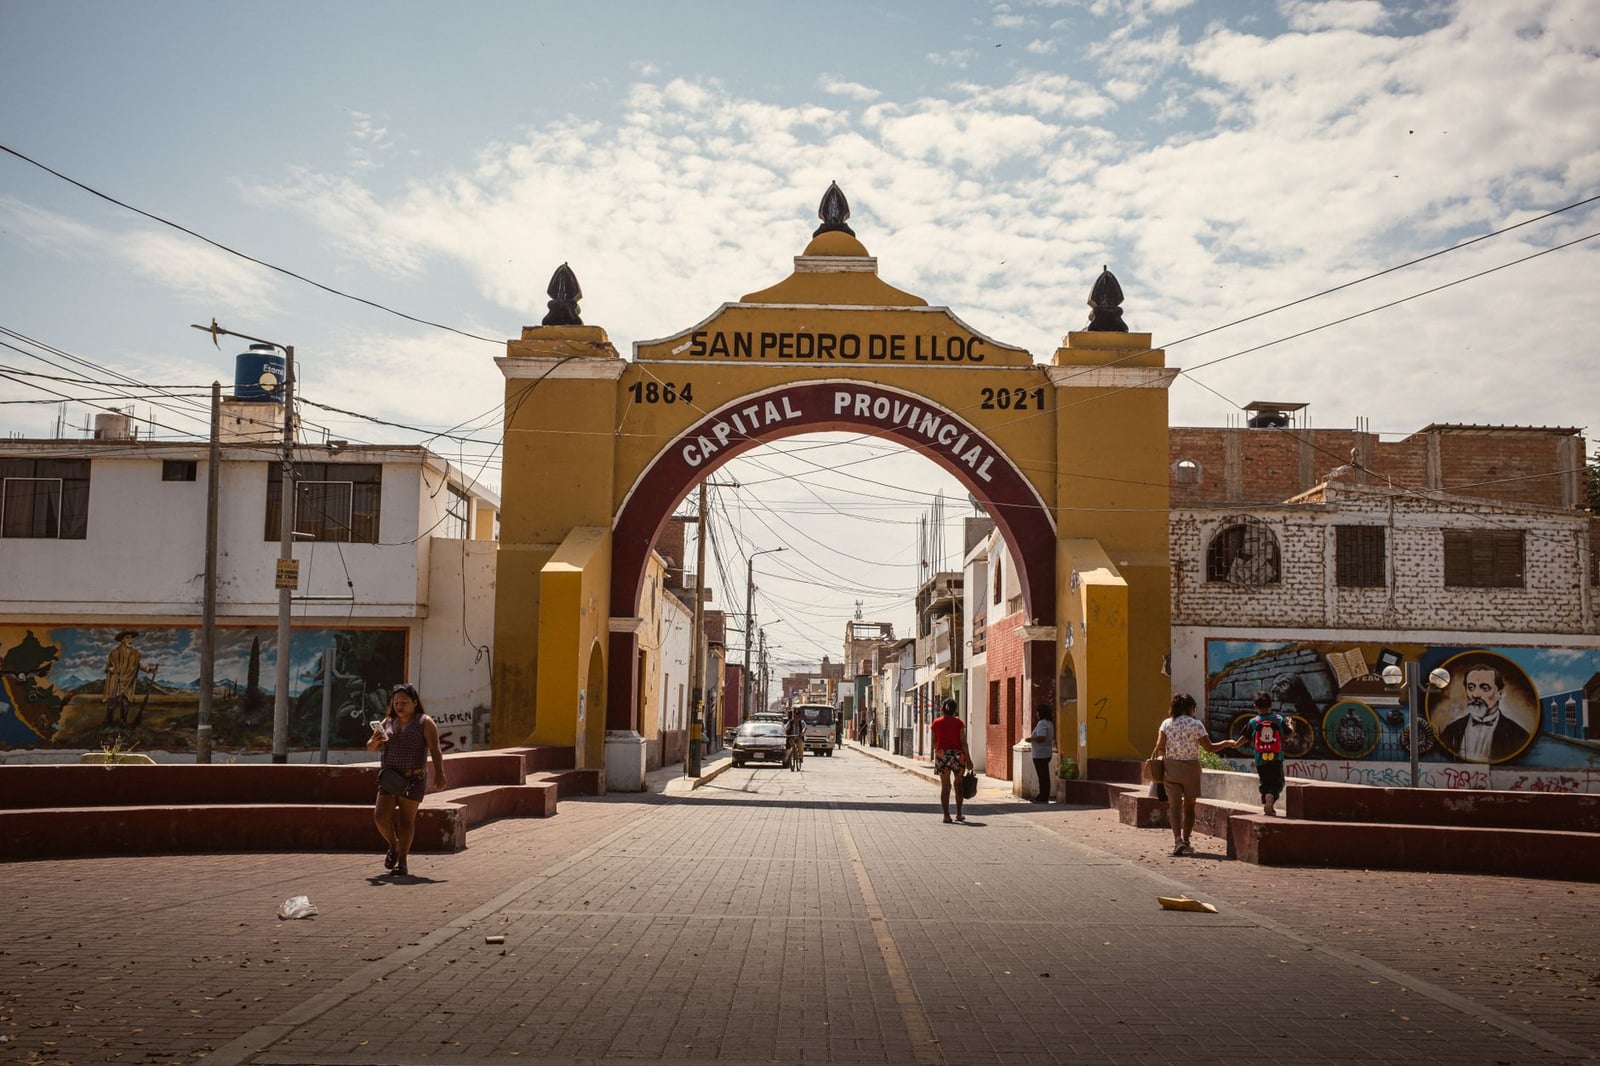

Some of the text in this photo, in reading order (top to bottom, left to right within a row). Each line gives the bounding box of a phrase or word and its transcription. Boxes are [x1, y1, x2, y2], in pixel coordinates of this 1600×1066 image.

[690, 331, 985, 362] SAN PEDRO DE LLOC
[628, 381, 694, 405] 1864
[981, 387, 1046, 411] 2021
[682, 391, 996, 483] CAPITAL PROVINCIAL
